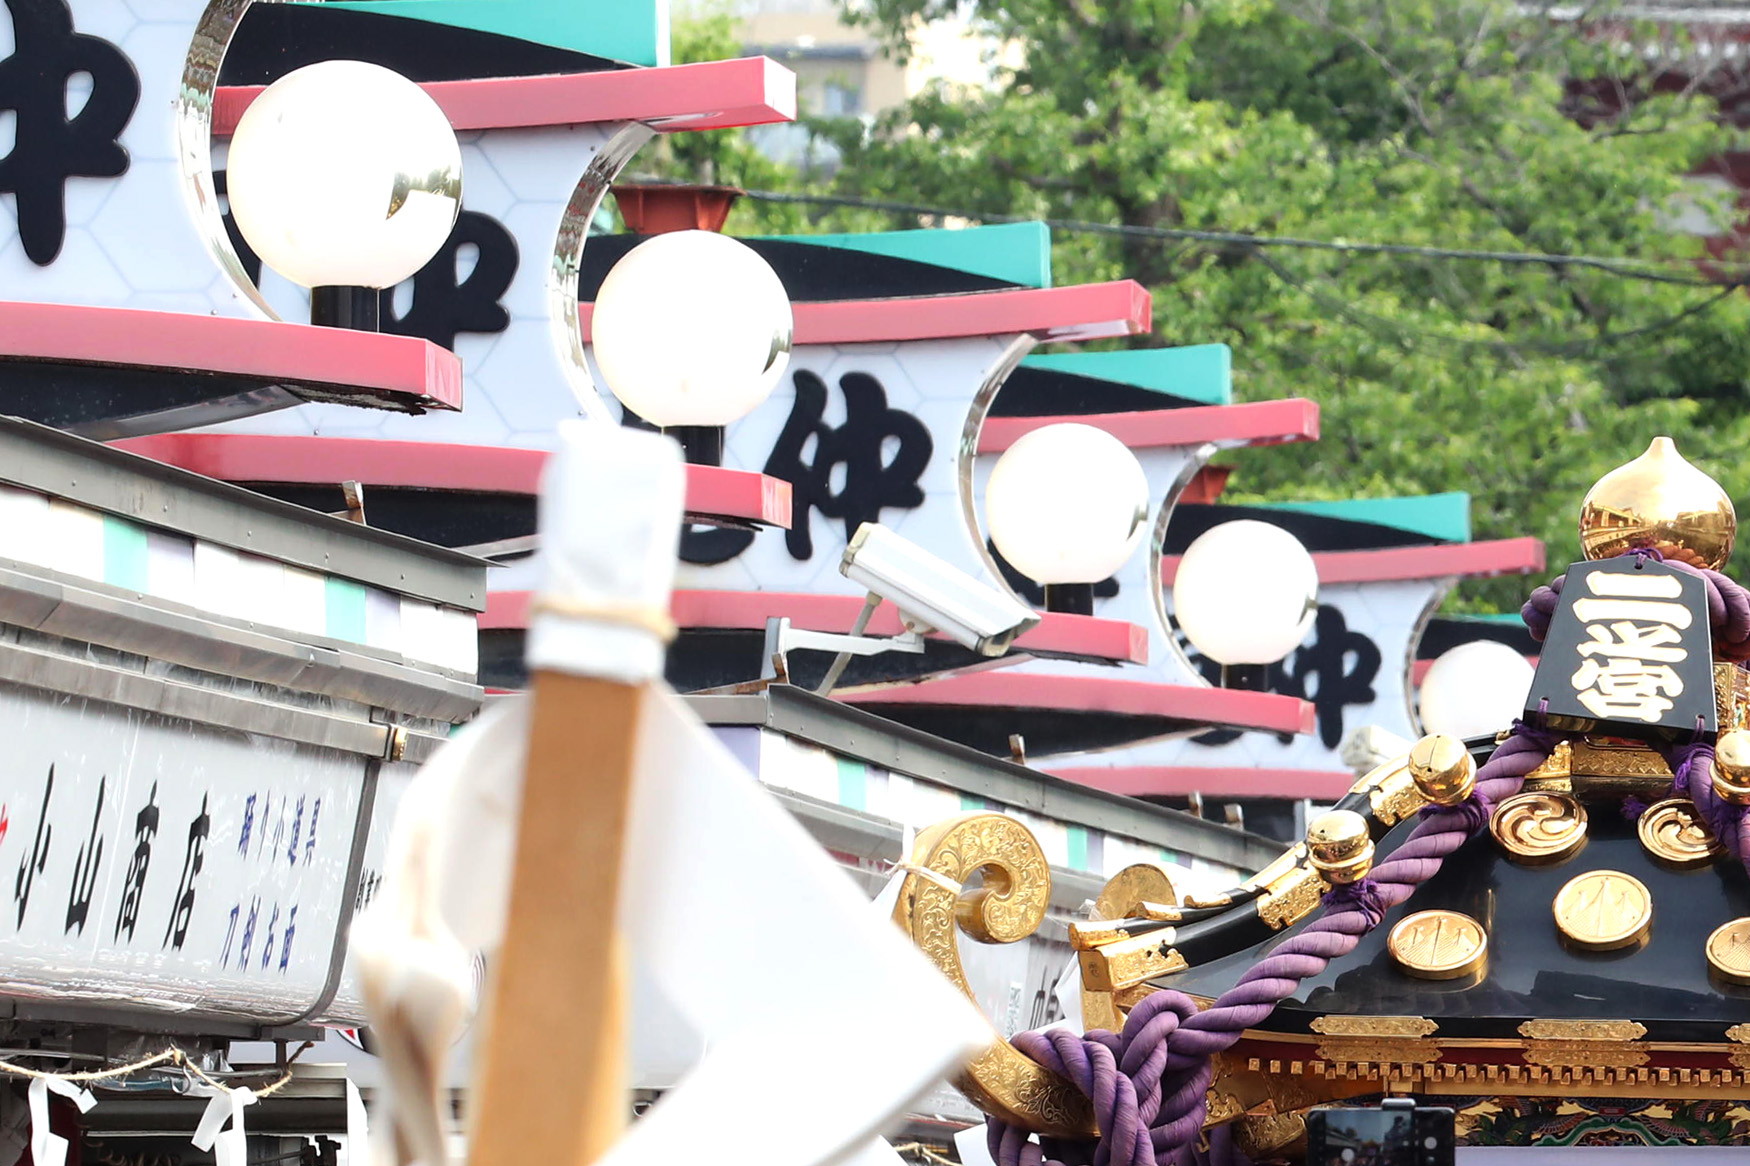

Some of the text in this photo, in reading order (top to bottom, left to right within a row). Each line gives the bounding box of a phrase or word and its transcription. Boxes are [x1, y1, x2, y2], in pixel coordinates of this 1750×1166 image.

[762, 368, 933, 561] 仲
[14, 762, 210, 952] 小山商店
